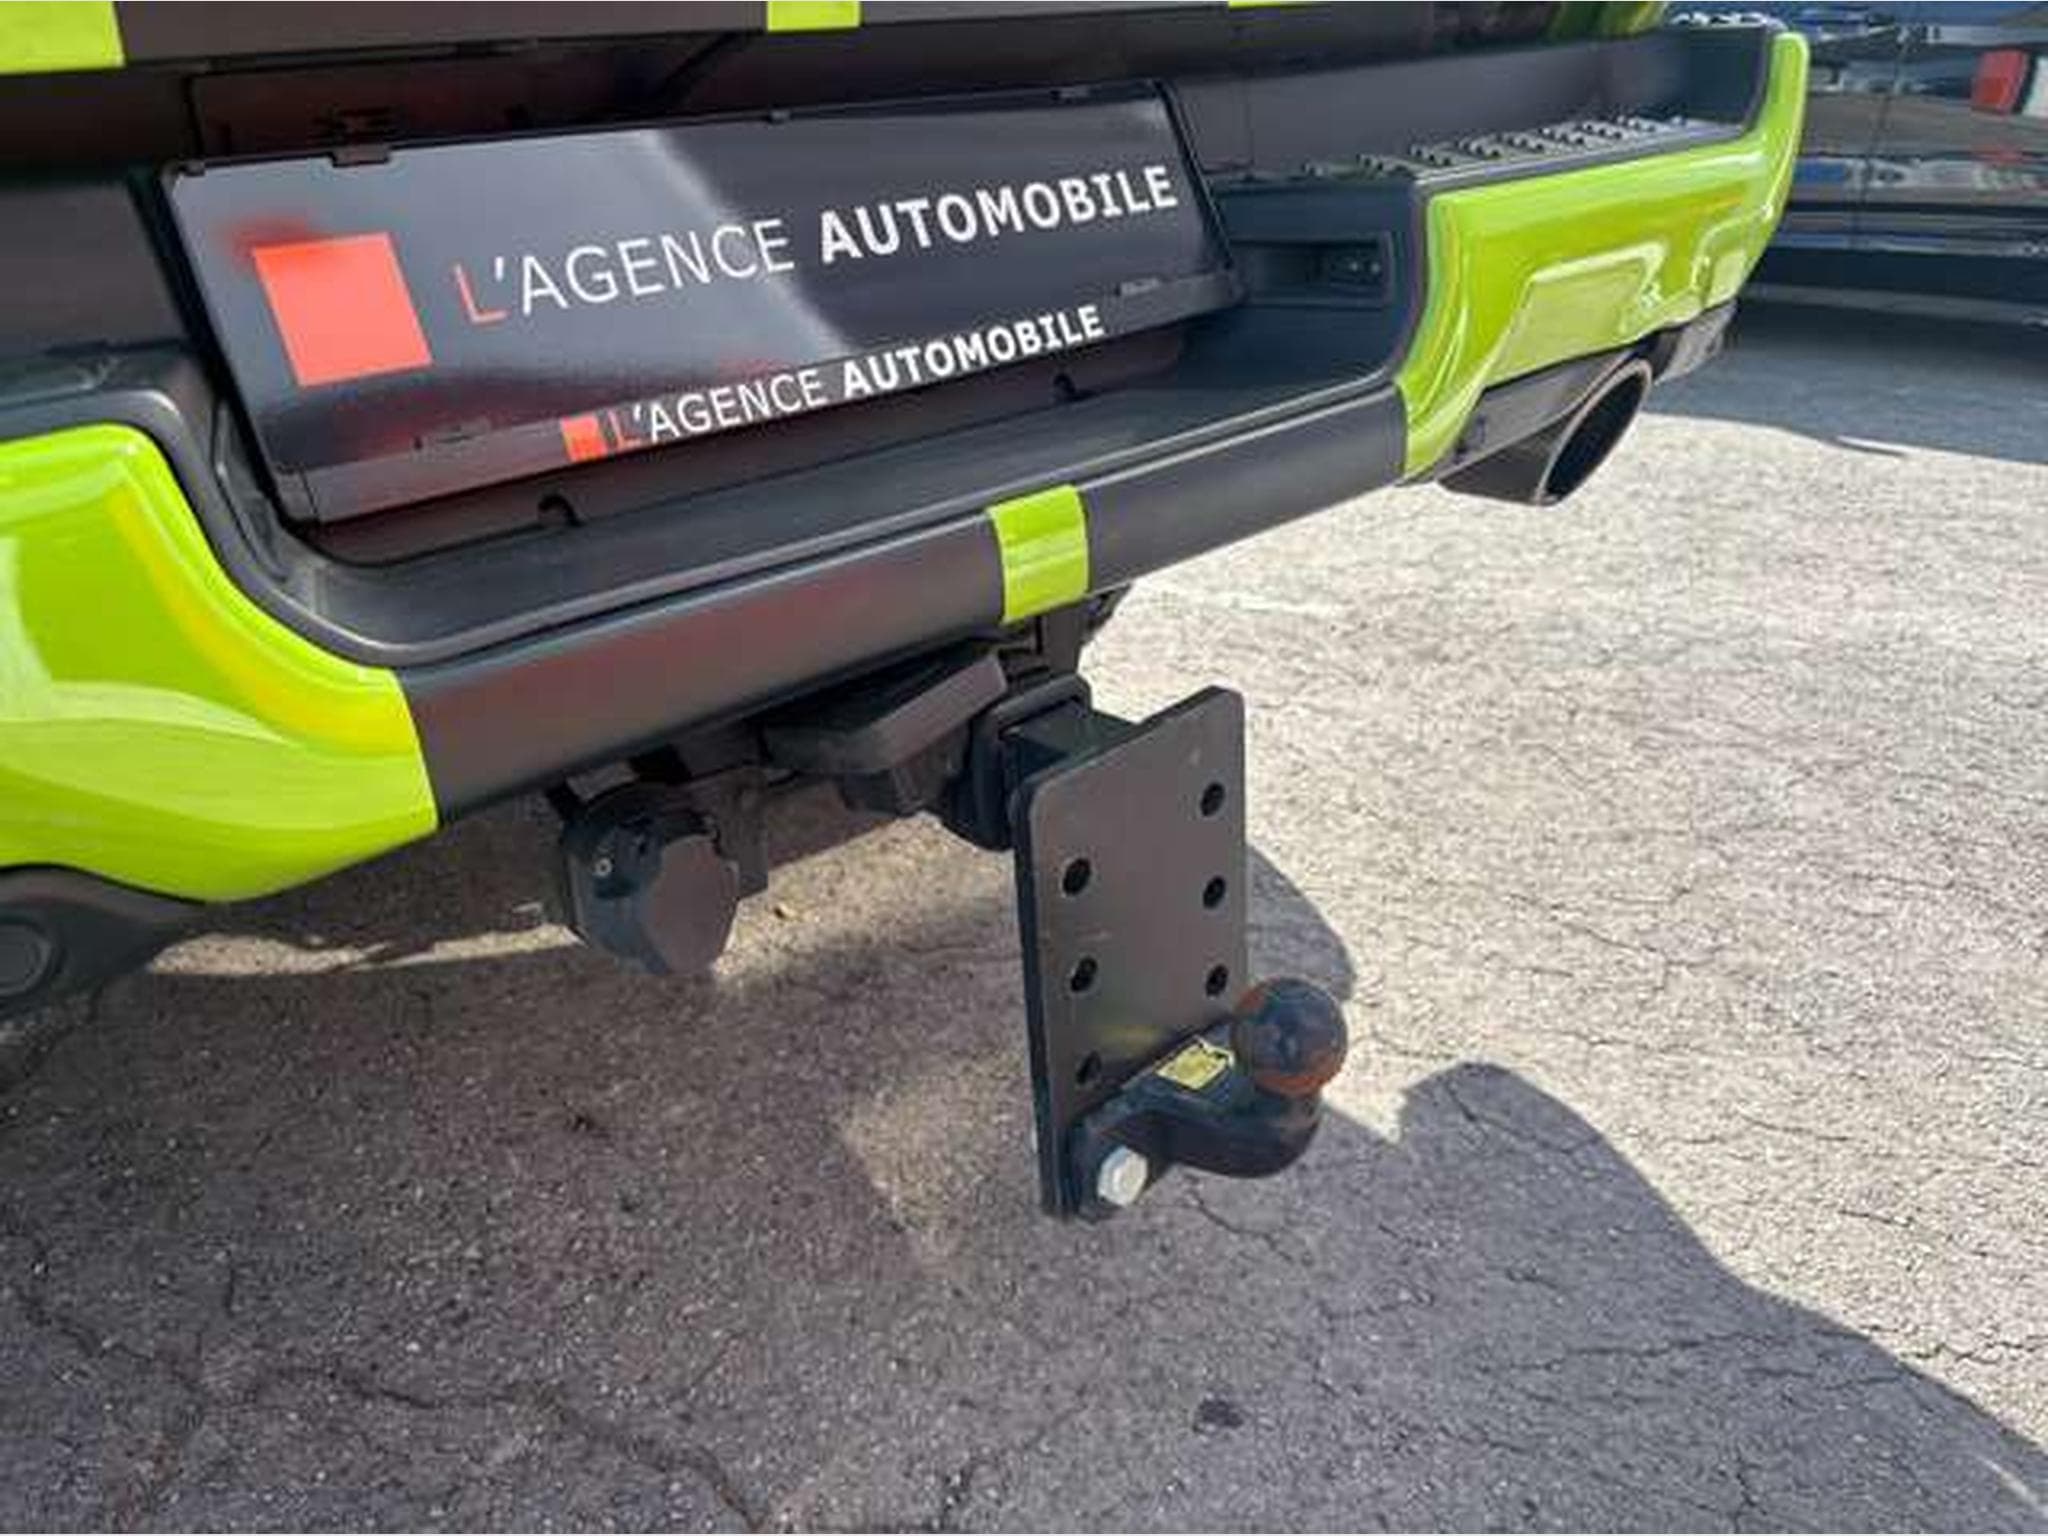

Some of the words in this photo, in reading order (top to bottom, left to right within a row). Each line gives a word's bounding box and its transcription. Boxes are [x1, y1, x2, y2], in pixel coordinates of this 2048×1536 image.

[455, 219, 795, 324] L'AGENCE
[819, 165, 1179, 264] AUTOMOBILE
[610, 369, 827, 448] L'AGENCE
[841, 305, 1105, 398] AUTOMOBILE
